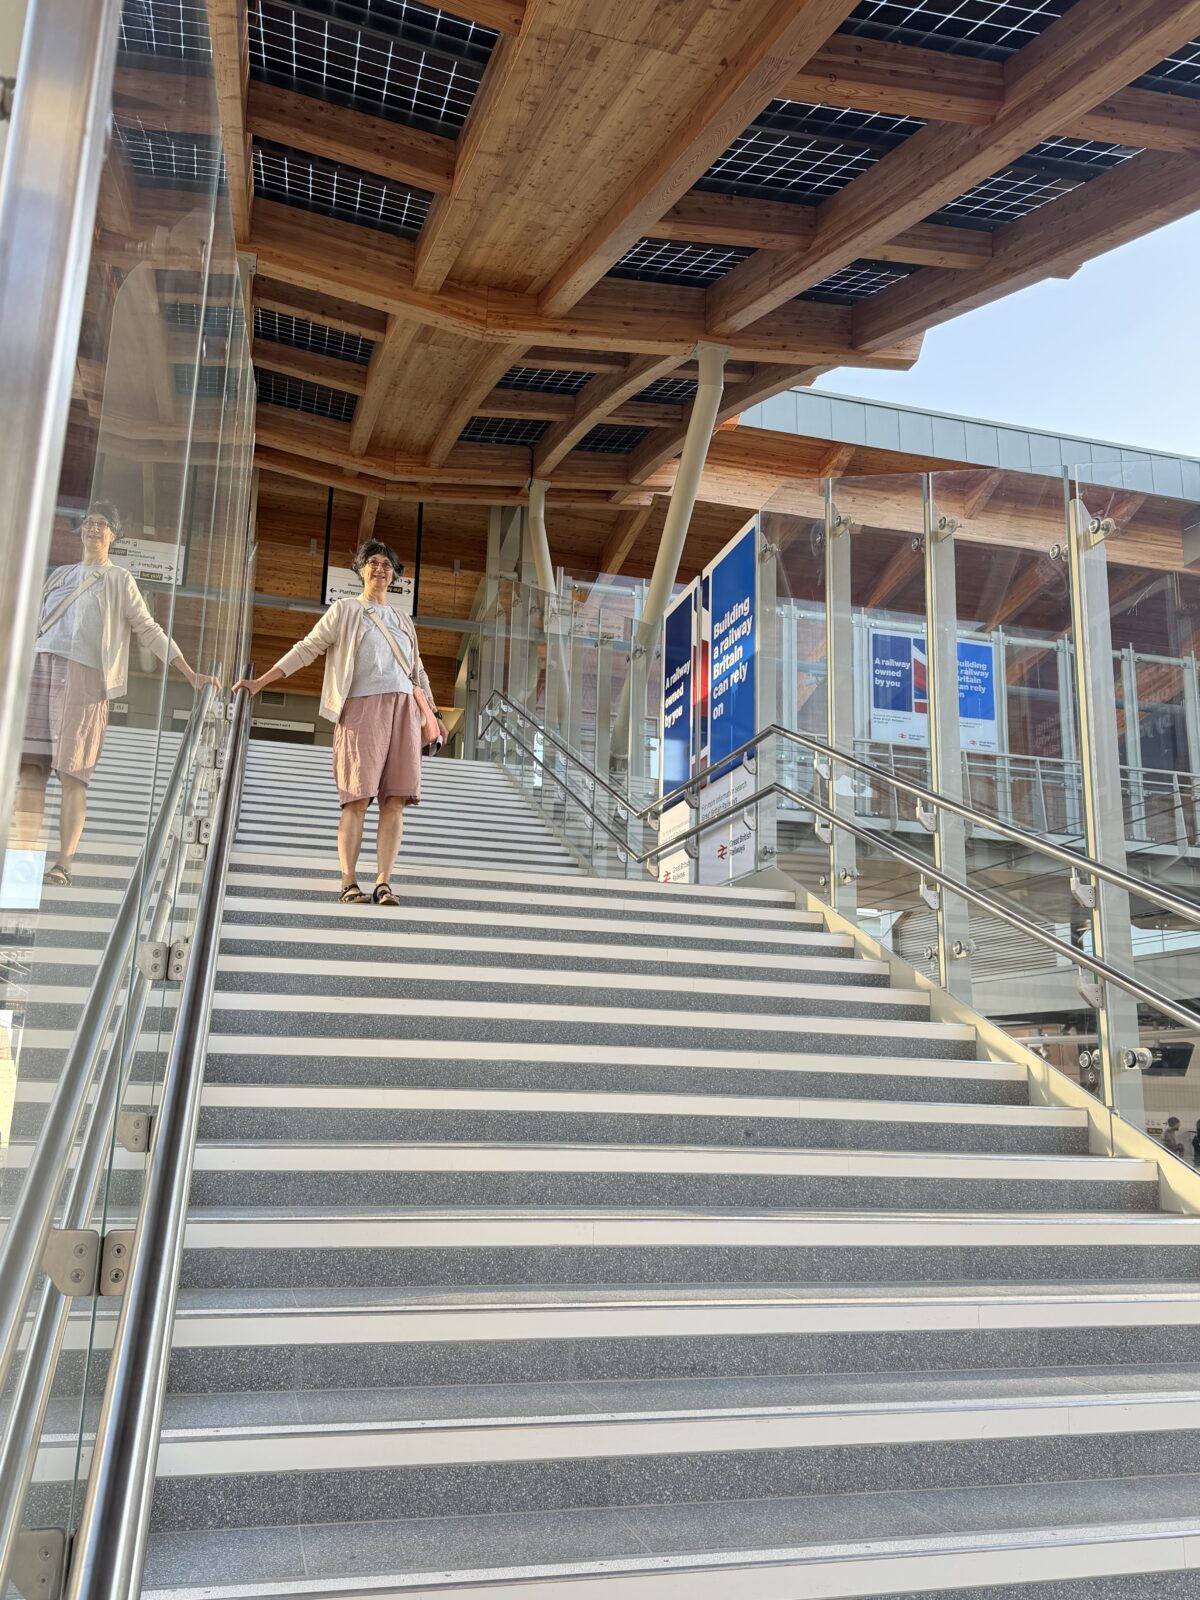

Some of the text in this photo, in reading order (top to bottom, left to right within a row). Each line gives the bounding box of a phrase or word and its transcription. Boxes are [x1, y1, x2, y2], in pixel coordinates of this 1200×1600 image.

[713, 596, 750, 640] Building
[713, 615, 753, 660] a railway
[665, 659, 691, 690] A railway
[713, 645, 743, 680] Britain
[874, 669, 902, 678] owned
[881, 659, 911, 670] railway
[960, 667, 990, 678] railway
[712, 661, 748, 700] can rely
[874, 677, 901, 688] by you
[970, 685, 986, 694] rely
[665, 681, 684, 709] owned
[712, 701, 724, 721] on
